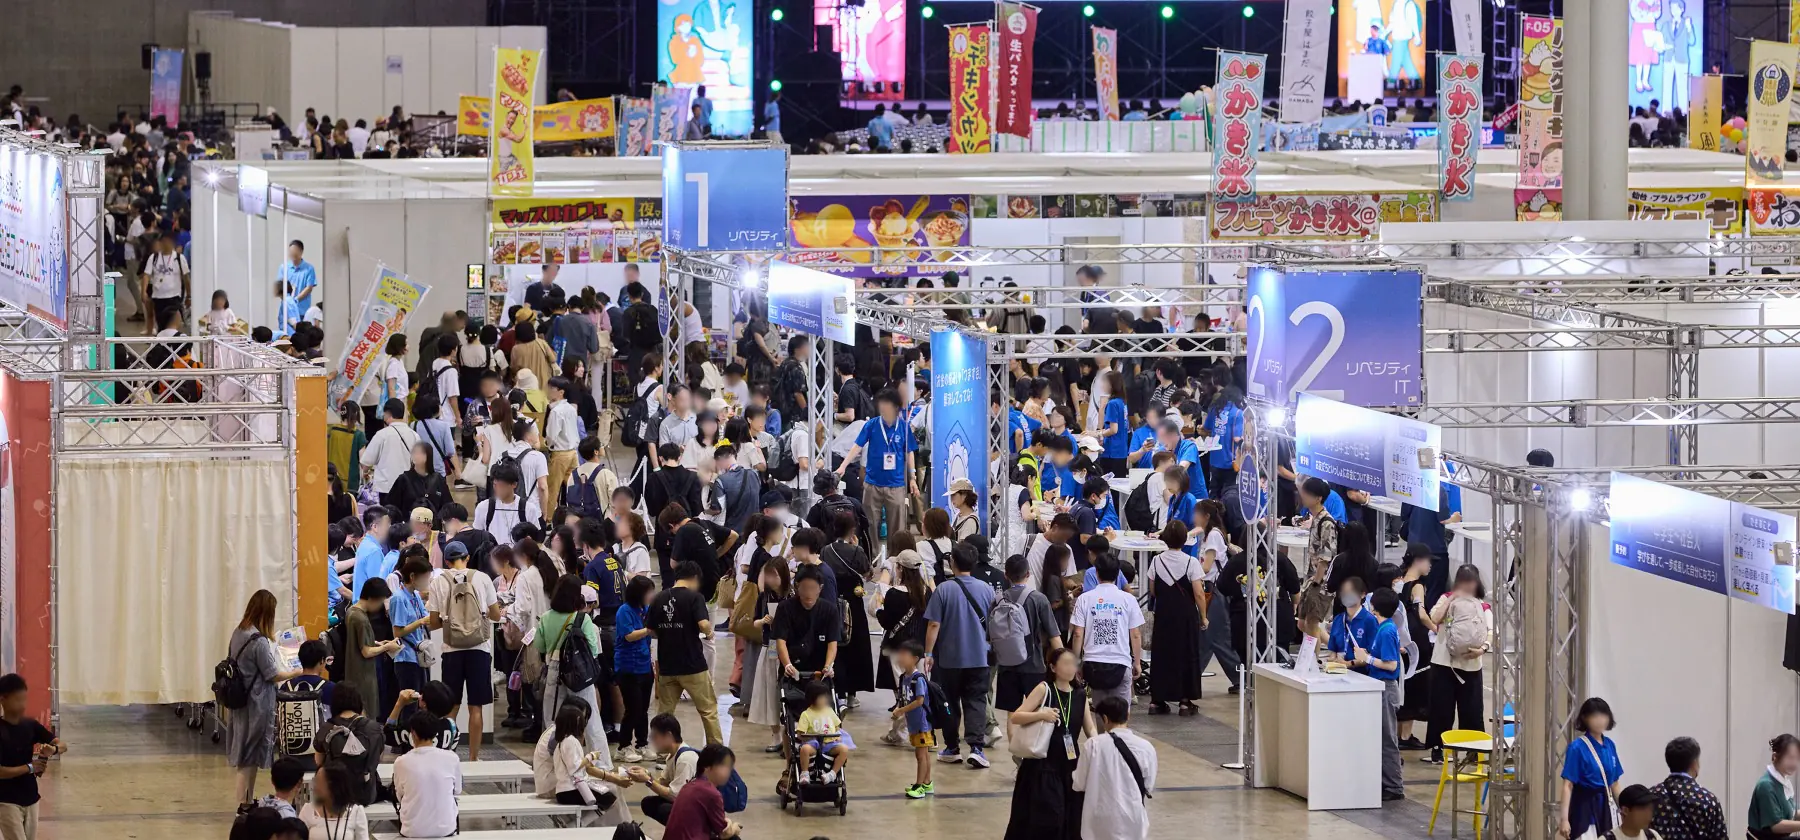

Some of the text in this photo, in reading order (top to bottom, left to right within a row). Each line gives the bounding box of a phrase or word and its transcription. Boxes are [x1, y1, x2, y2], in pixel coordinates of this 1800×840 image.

[1526, 21, 1551, 33] F-05
[1217, 82, 1258, 198] かき氷
[499, 201, 609, 228] マッスルカフェ
[685, 172, 709, 247] 1
[728, 230, 778, 242] リベシティ
[1289, 301, 1345, 403] 2
[1346, 362, 1411, 376] リベシティ
[1395, 380, 1411, 395] IT
[1241, 470, 1256, 497] 受付
[286, 712, 294, 738] FACE
[293, 702, 302, 739] NORTH
[303, 717, 311, 737] THE
